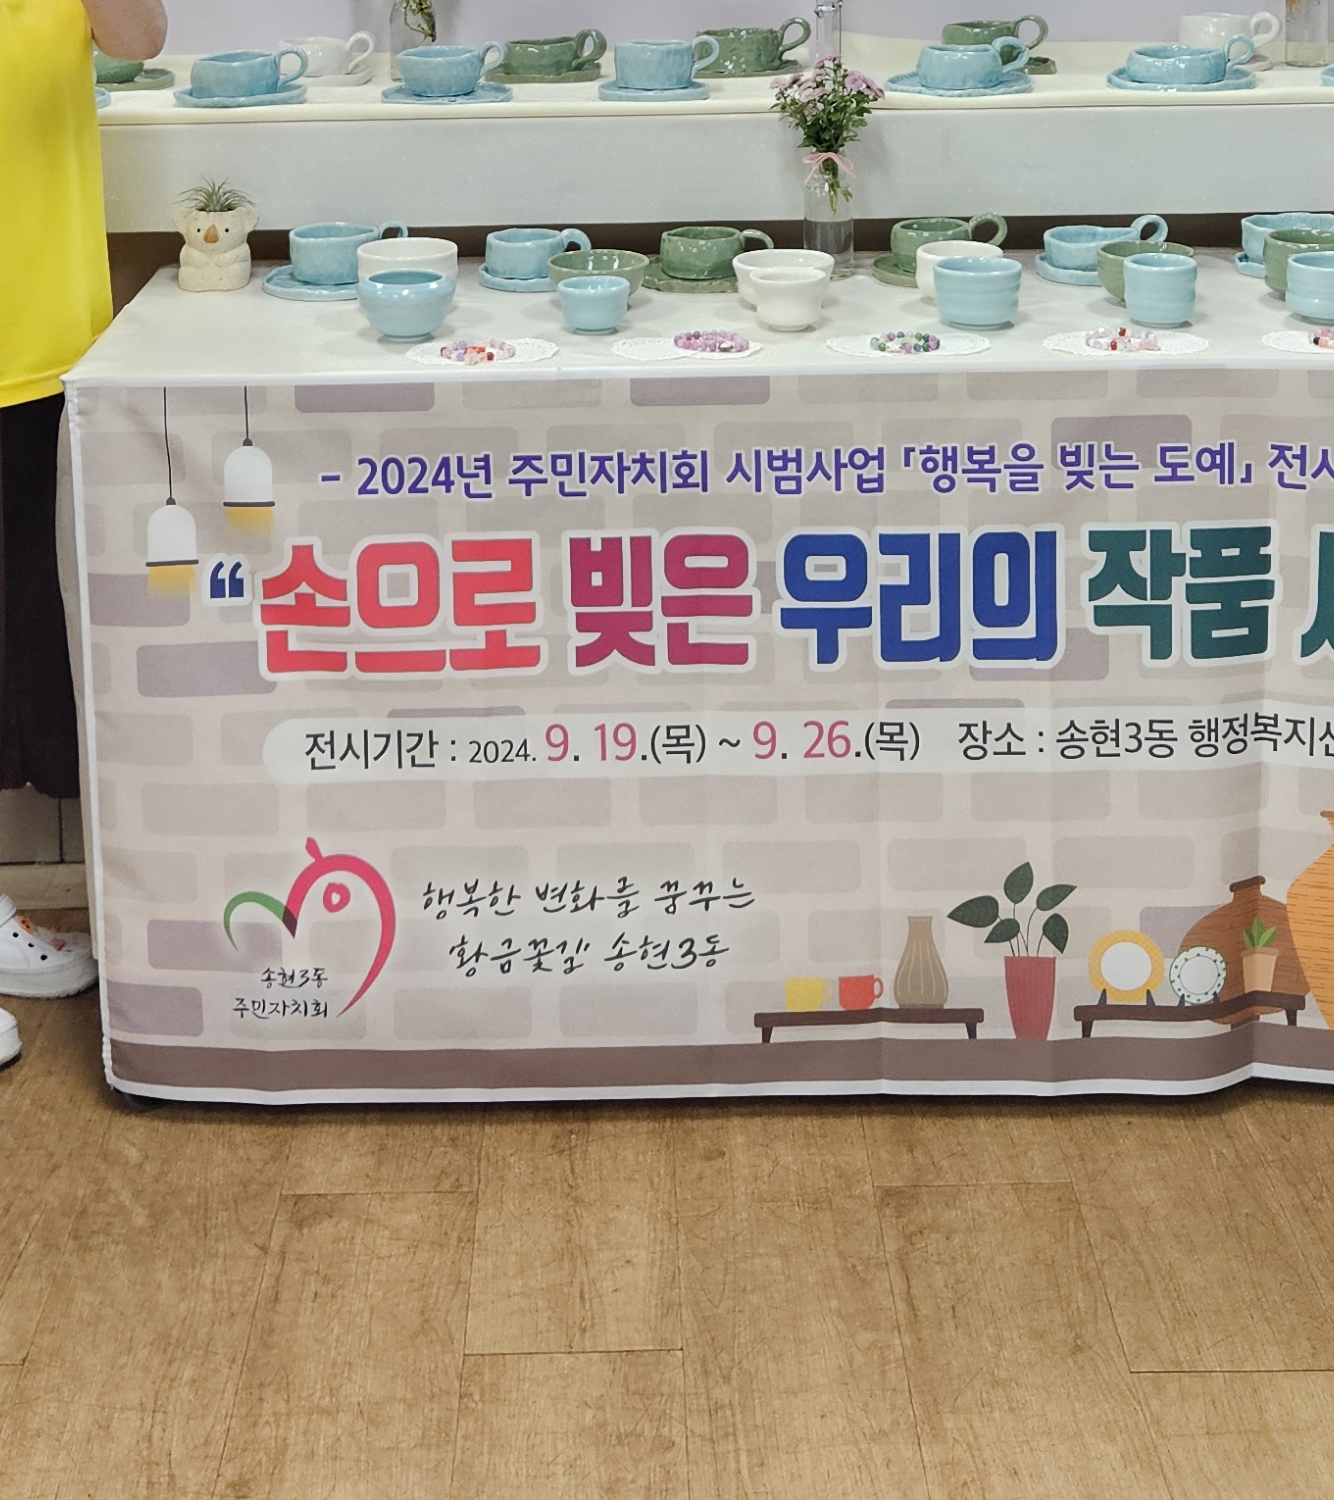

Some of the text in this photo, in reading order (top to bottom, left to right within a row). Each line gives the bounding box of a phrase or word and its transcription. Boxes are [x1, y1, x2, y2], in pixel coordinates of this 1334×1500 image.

[357, 453, 493, 499] 2024년
[508, 449, 708, 498] 주민자치회
[726, 446, 885, 495] 시범사업
[903, 443, 1044, 494] 「행복을
[1060, 443, 1140, 491] 빚는
[1154, 442, 1252, 485] 도예」
[569, 534, 753, 668] 빚은
[780, 530, 1058, 665] 우리의
[1088, 526, 1276, 660] 작품
[305, 729, 439, 771] 전시기간
[468, 738, 537, 764] 2024.
[958, 720, 1027, 761] 장소
[1055, 718, 1178, 760] 송현3동
[422, 876, 755, 920] 행복한 변화를 꿈꾸는
[603, 931, 730, 972] 송현3동
[260, 967, 329, 989] 송현3동
[233, 997, 328, 1019] 주민자치회
